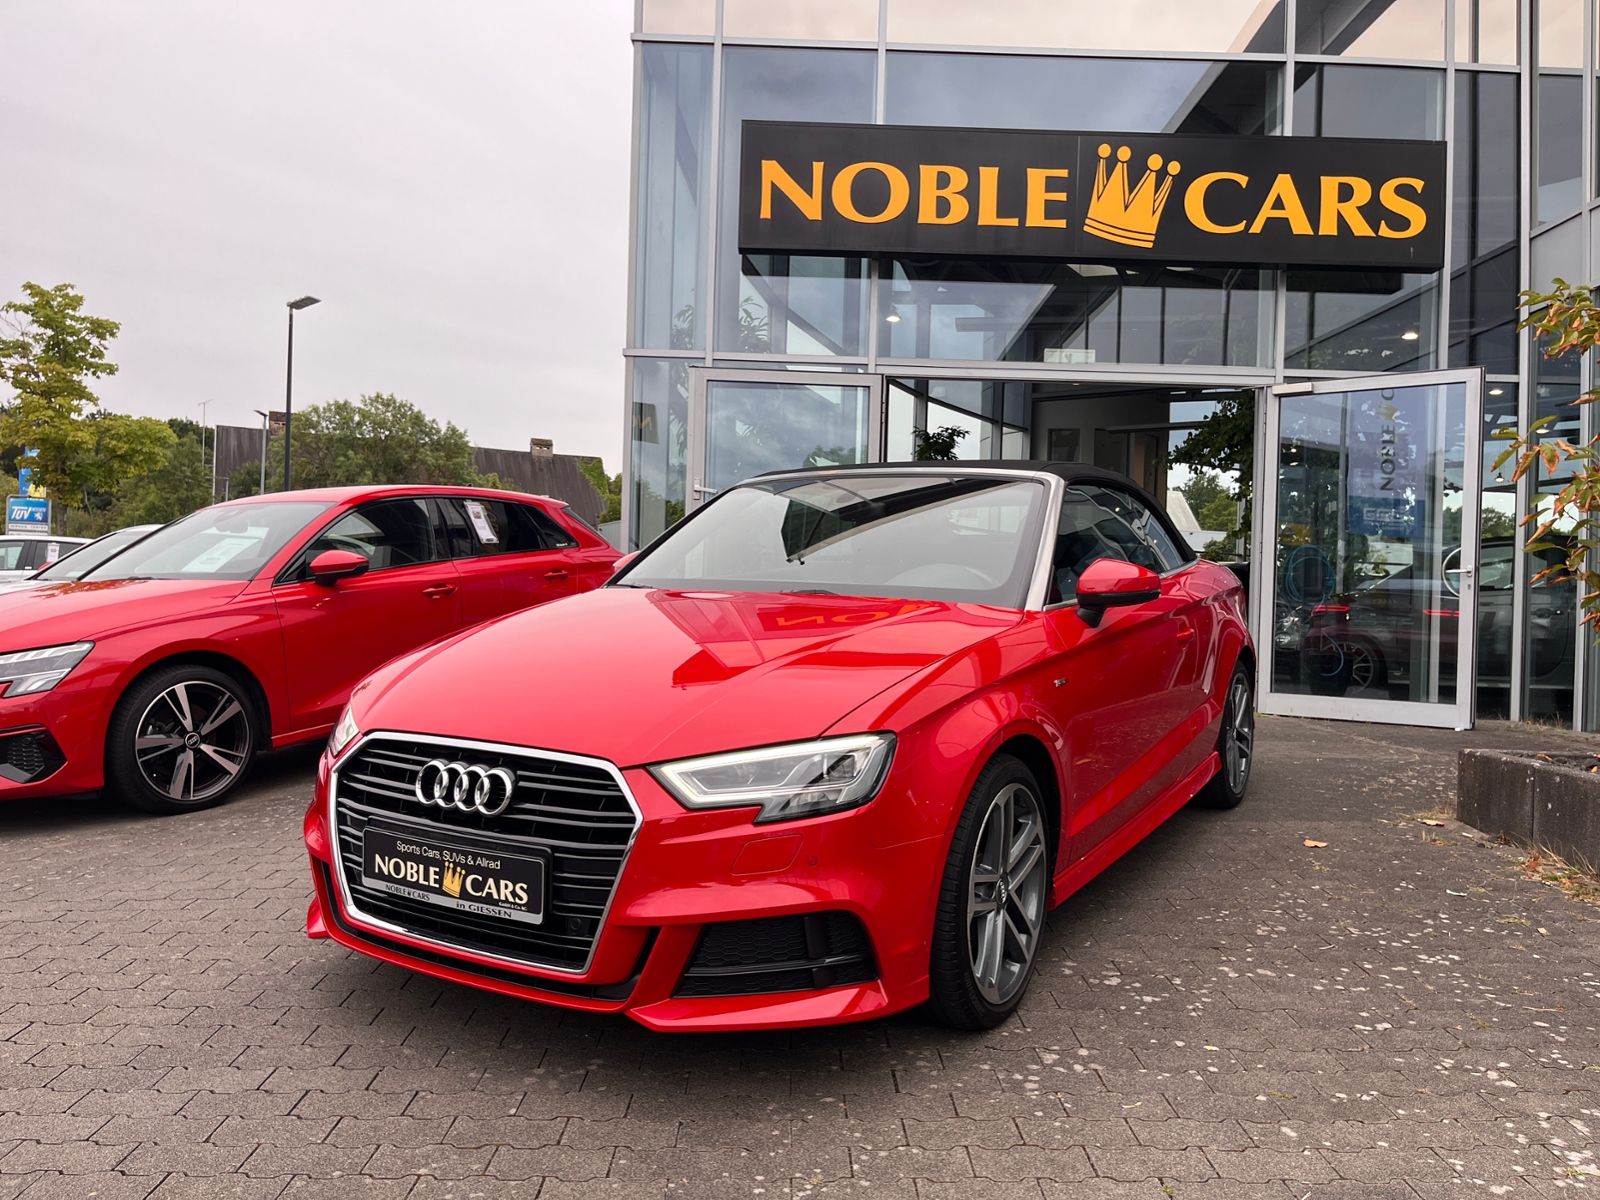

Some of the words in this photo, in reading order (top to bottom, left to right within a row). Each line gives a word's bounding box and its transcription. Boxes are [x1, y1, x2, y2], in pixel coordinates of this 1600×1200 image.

[759, 159, 1069, 229] NOBLE
[1184, 171, 1427, 240] CARS
[396, 841, 421, 855] Sports
[421, 846, 442, 860] Cars,
[442, 850, 466, 865] SUVs
[467, 854, 474, 865] &
[475, 856, 501, 870] Allrad
[374, 853, 440, 888] NOBLE
[465, 874, 529, 905] CARS
[385, 883, 407, 896] NOBLE
[411, 890, 431, 902] CARS
[456, 901, 465, 910] in
[468, 903, 512, 919] GIESSEN
